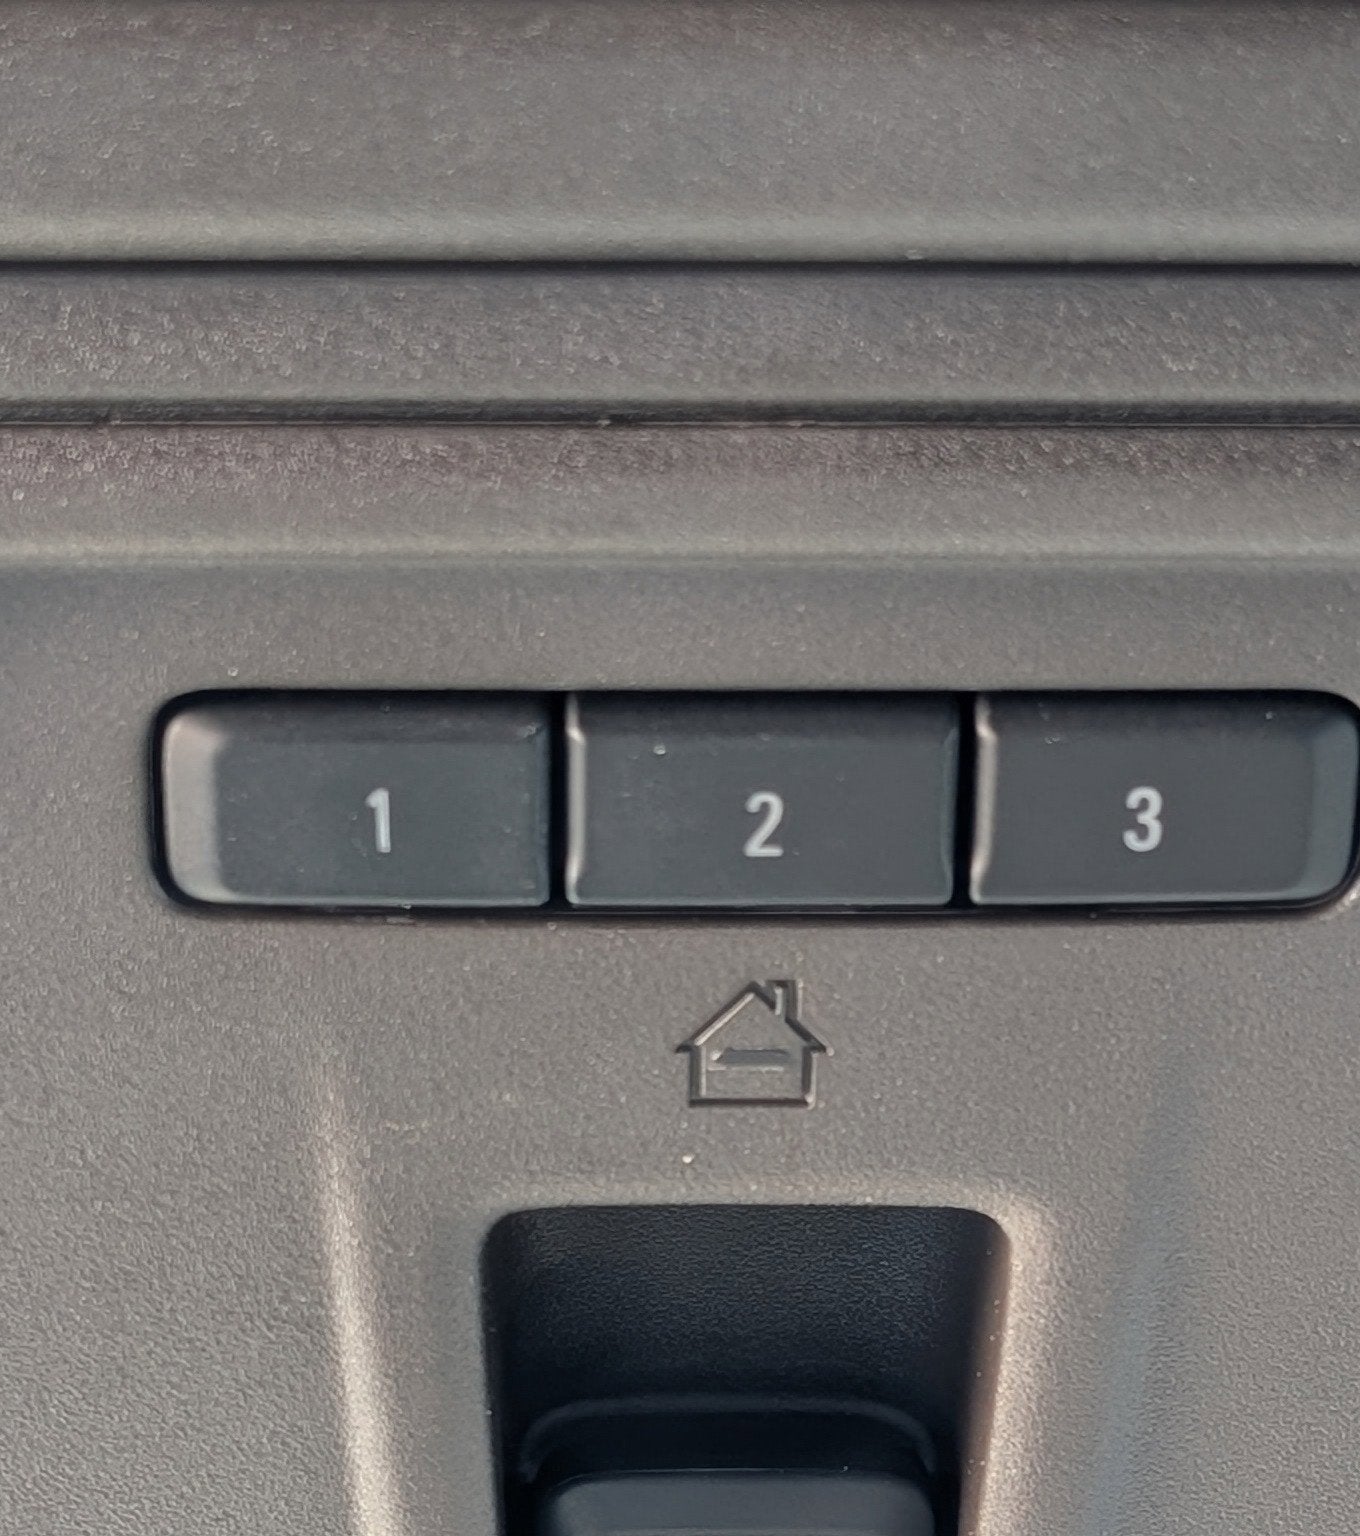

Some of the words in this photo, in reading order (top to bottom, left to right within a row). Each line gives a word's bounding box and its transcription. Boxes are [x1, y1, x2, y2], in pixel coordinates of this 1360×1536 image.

[363, 786, 394, 855] 1
[743, 790, 786, 860] 2
[1121, 785, 1164, 853] 3
